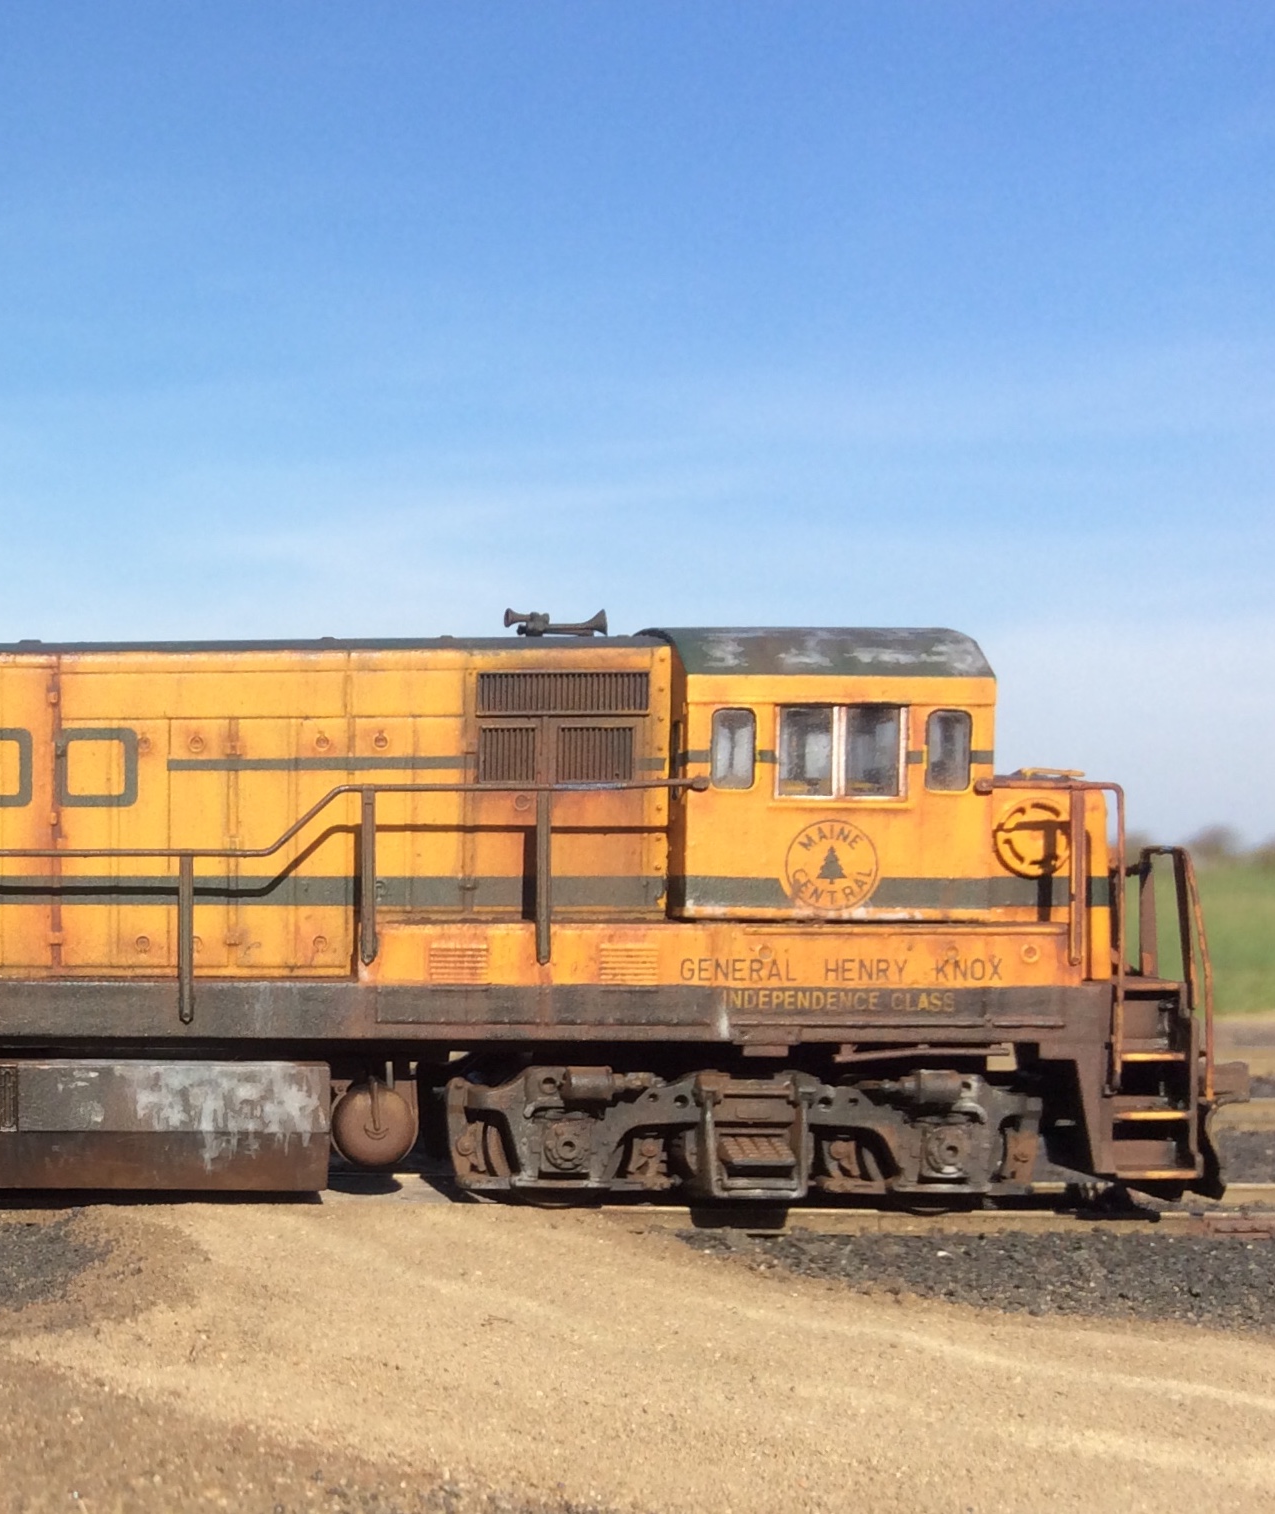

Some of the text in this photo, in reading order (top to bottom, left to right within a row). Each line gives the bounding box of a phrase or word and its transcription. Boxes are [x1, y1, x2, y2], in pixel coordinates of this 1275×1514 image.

[797, 824, 864, 851] MAINE
[792, 868, 873, 905] CENTRAL
[680, 957, 1003, 982] GENERAL HENRY KNOX
[722, 989, 955, 1013] INDEPENDENCE CLASS
